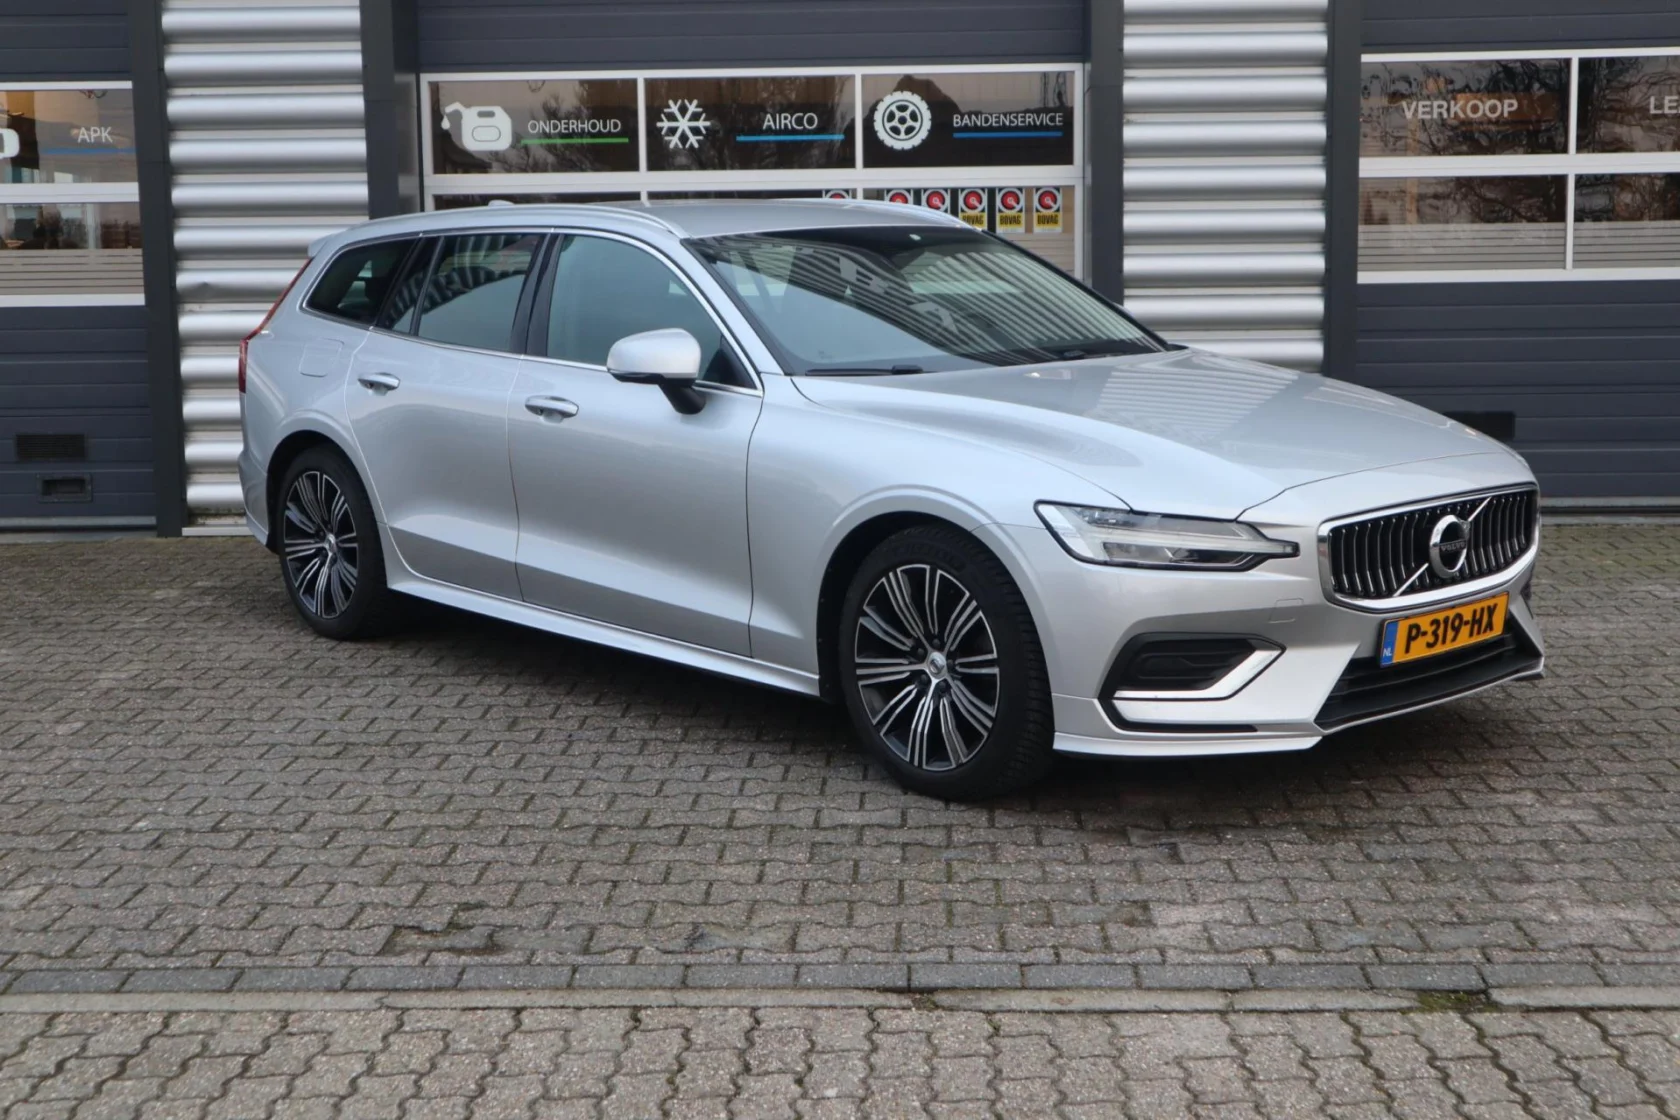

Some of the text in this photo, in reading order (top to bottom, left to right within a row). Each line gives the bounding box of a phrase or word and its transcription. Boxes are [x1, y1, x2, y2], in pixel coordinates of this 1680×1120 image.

[1402, 98, 1518, 120] VERKOOP
[1650, 95, 1680, 114] LE
[527, 119, 621, 134] ONDERHOUD
[763, 112, 818, 130] AIRCO
[953, 112, 1063, 128] BANDENSERVICE
[77, 126, 113, 143] APK
[1000, 215, 1021, 225] BOVAG
[1037, 215, 1058, 225] BOVAG
[1440, 541, 1465, 552] VOLVO
[1382, 603, 1498, 658] NL P-319-HX
